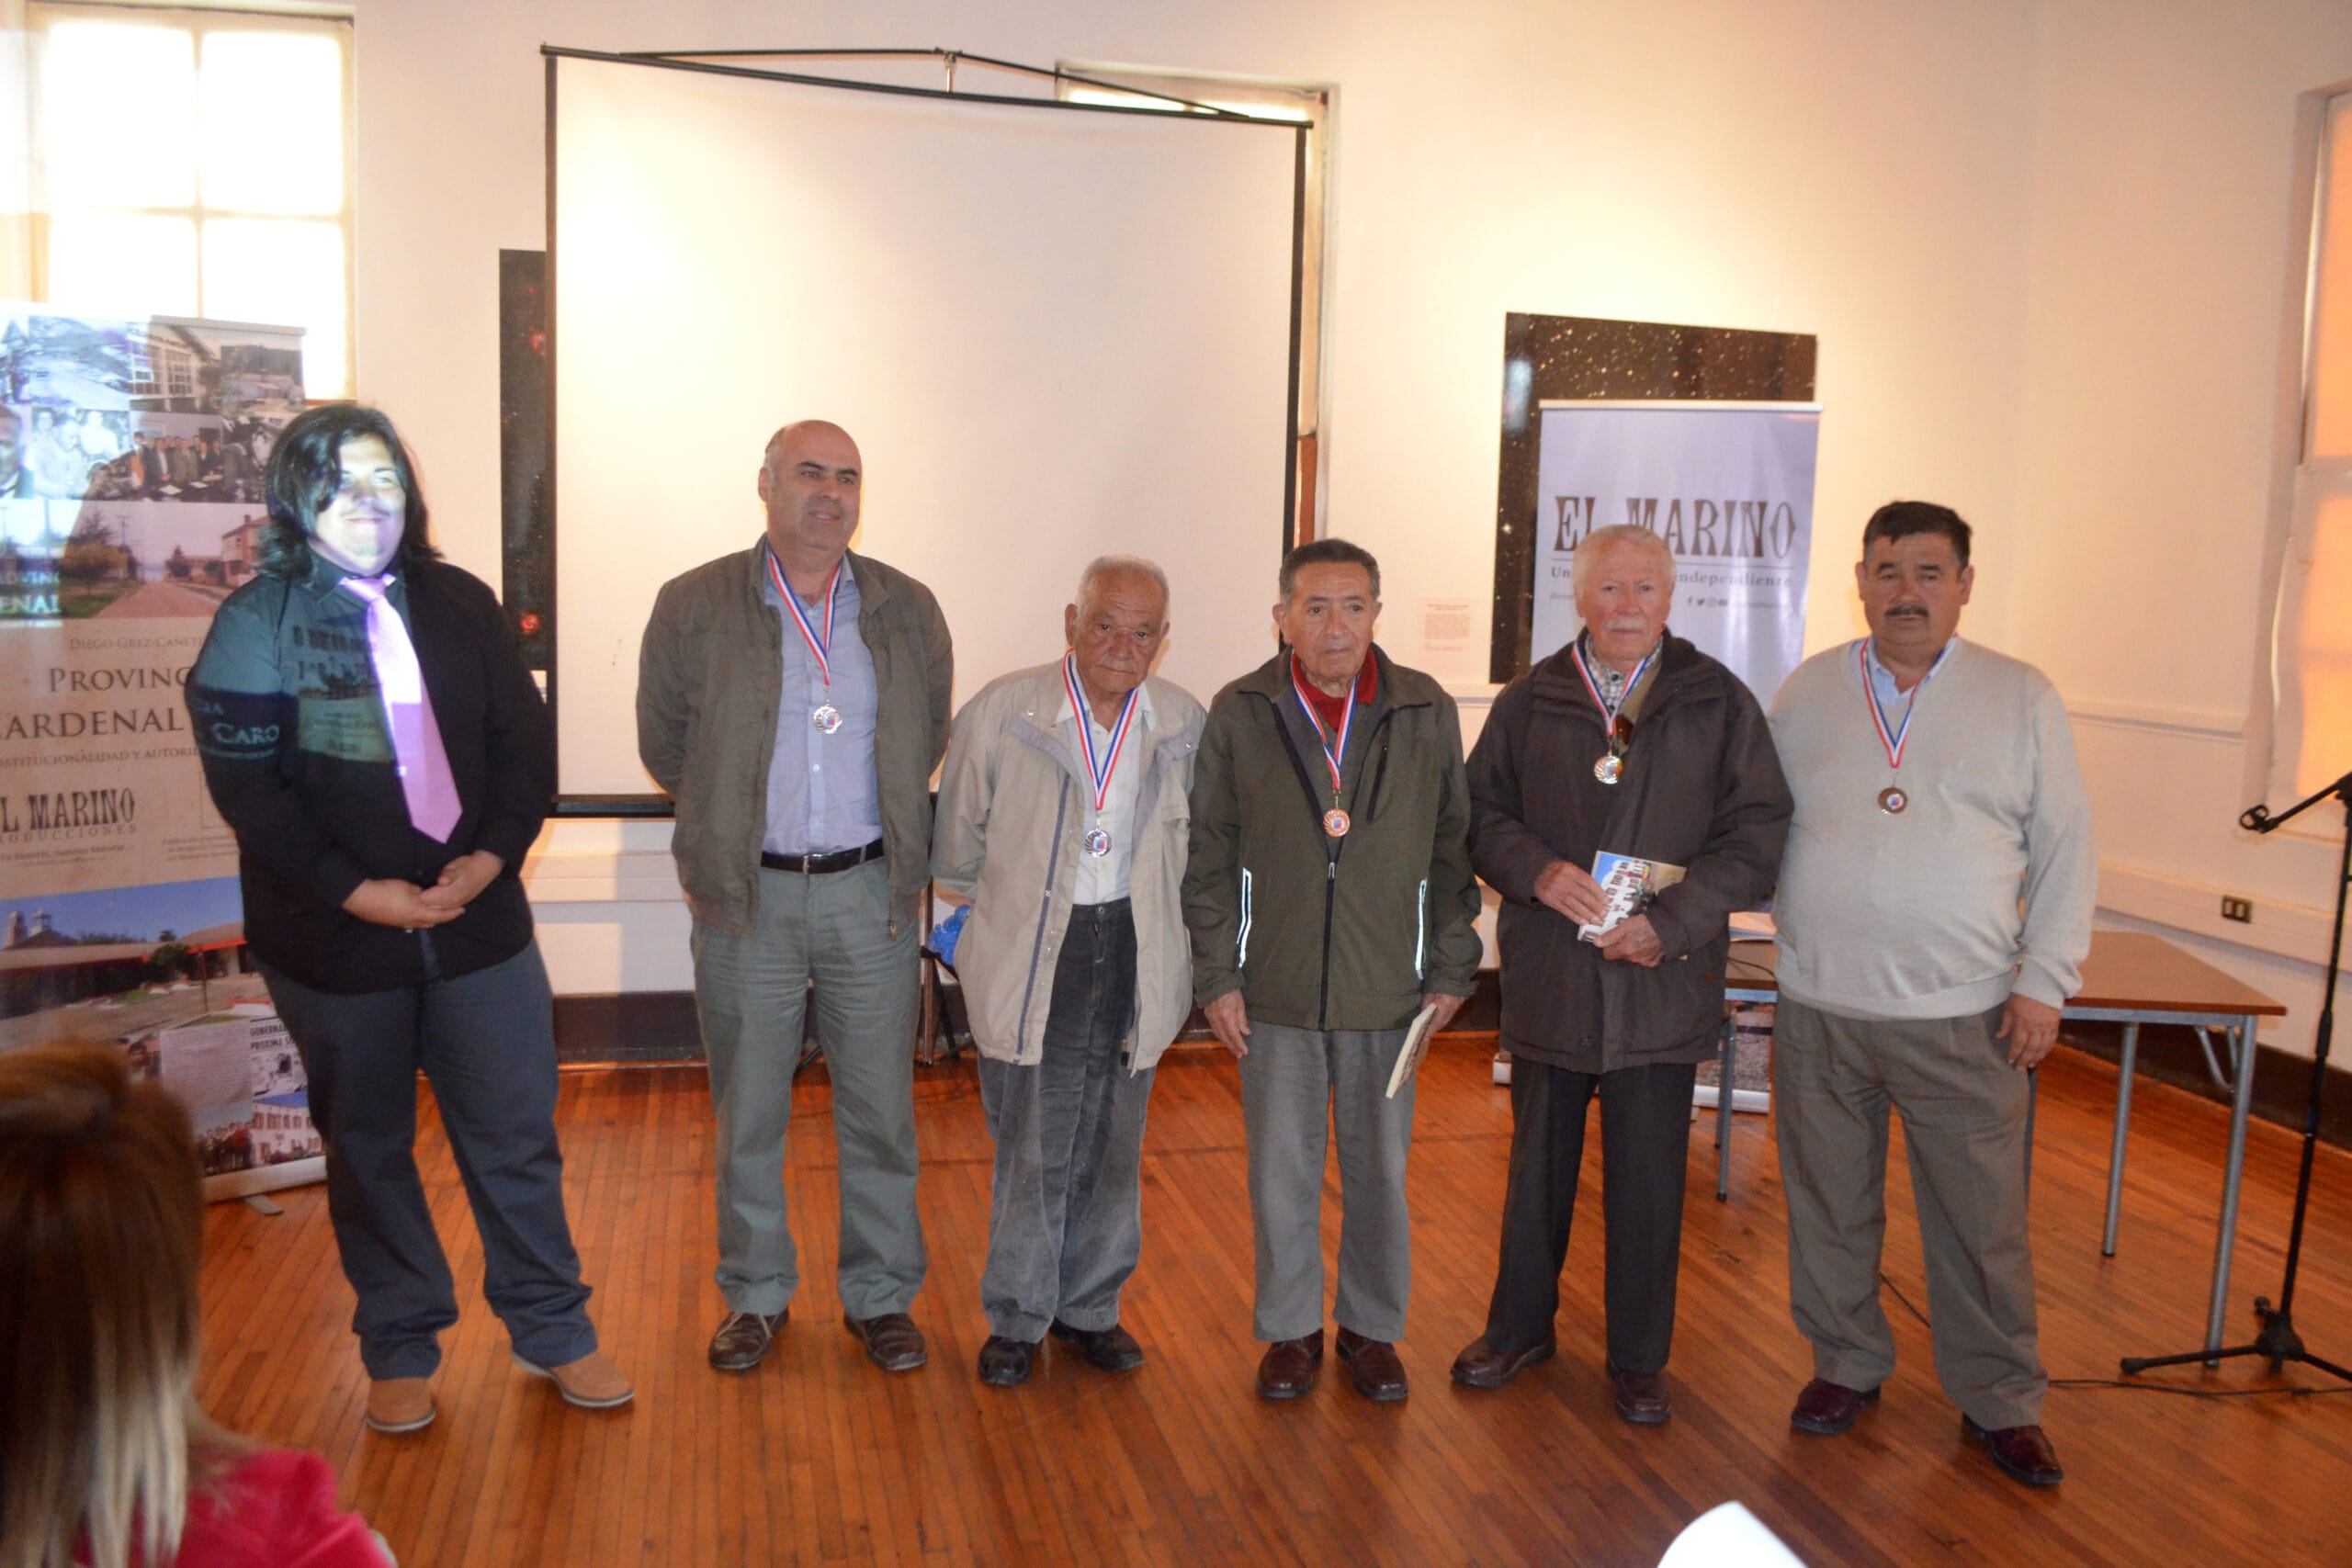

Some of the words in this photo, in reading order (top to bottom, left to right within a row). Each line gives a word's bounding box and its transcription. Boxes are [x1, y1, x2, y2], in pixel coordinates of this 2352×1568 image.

[0, 707, 184, 740] ARDENAL
[212, 723, 280, 745] CARO
[28, 788, 135, 830] MARINO
